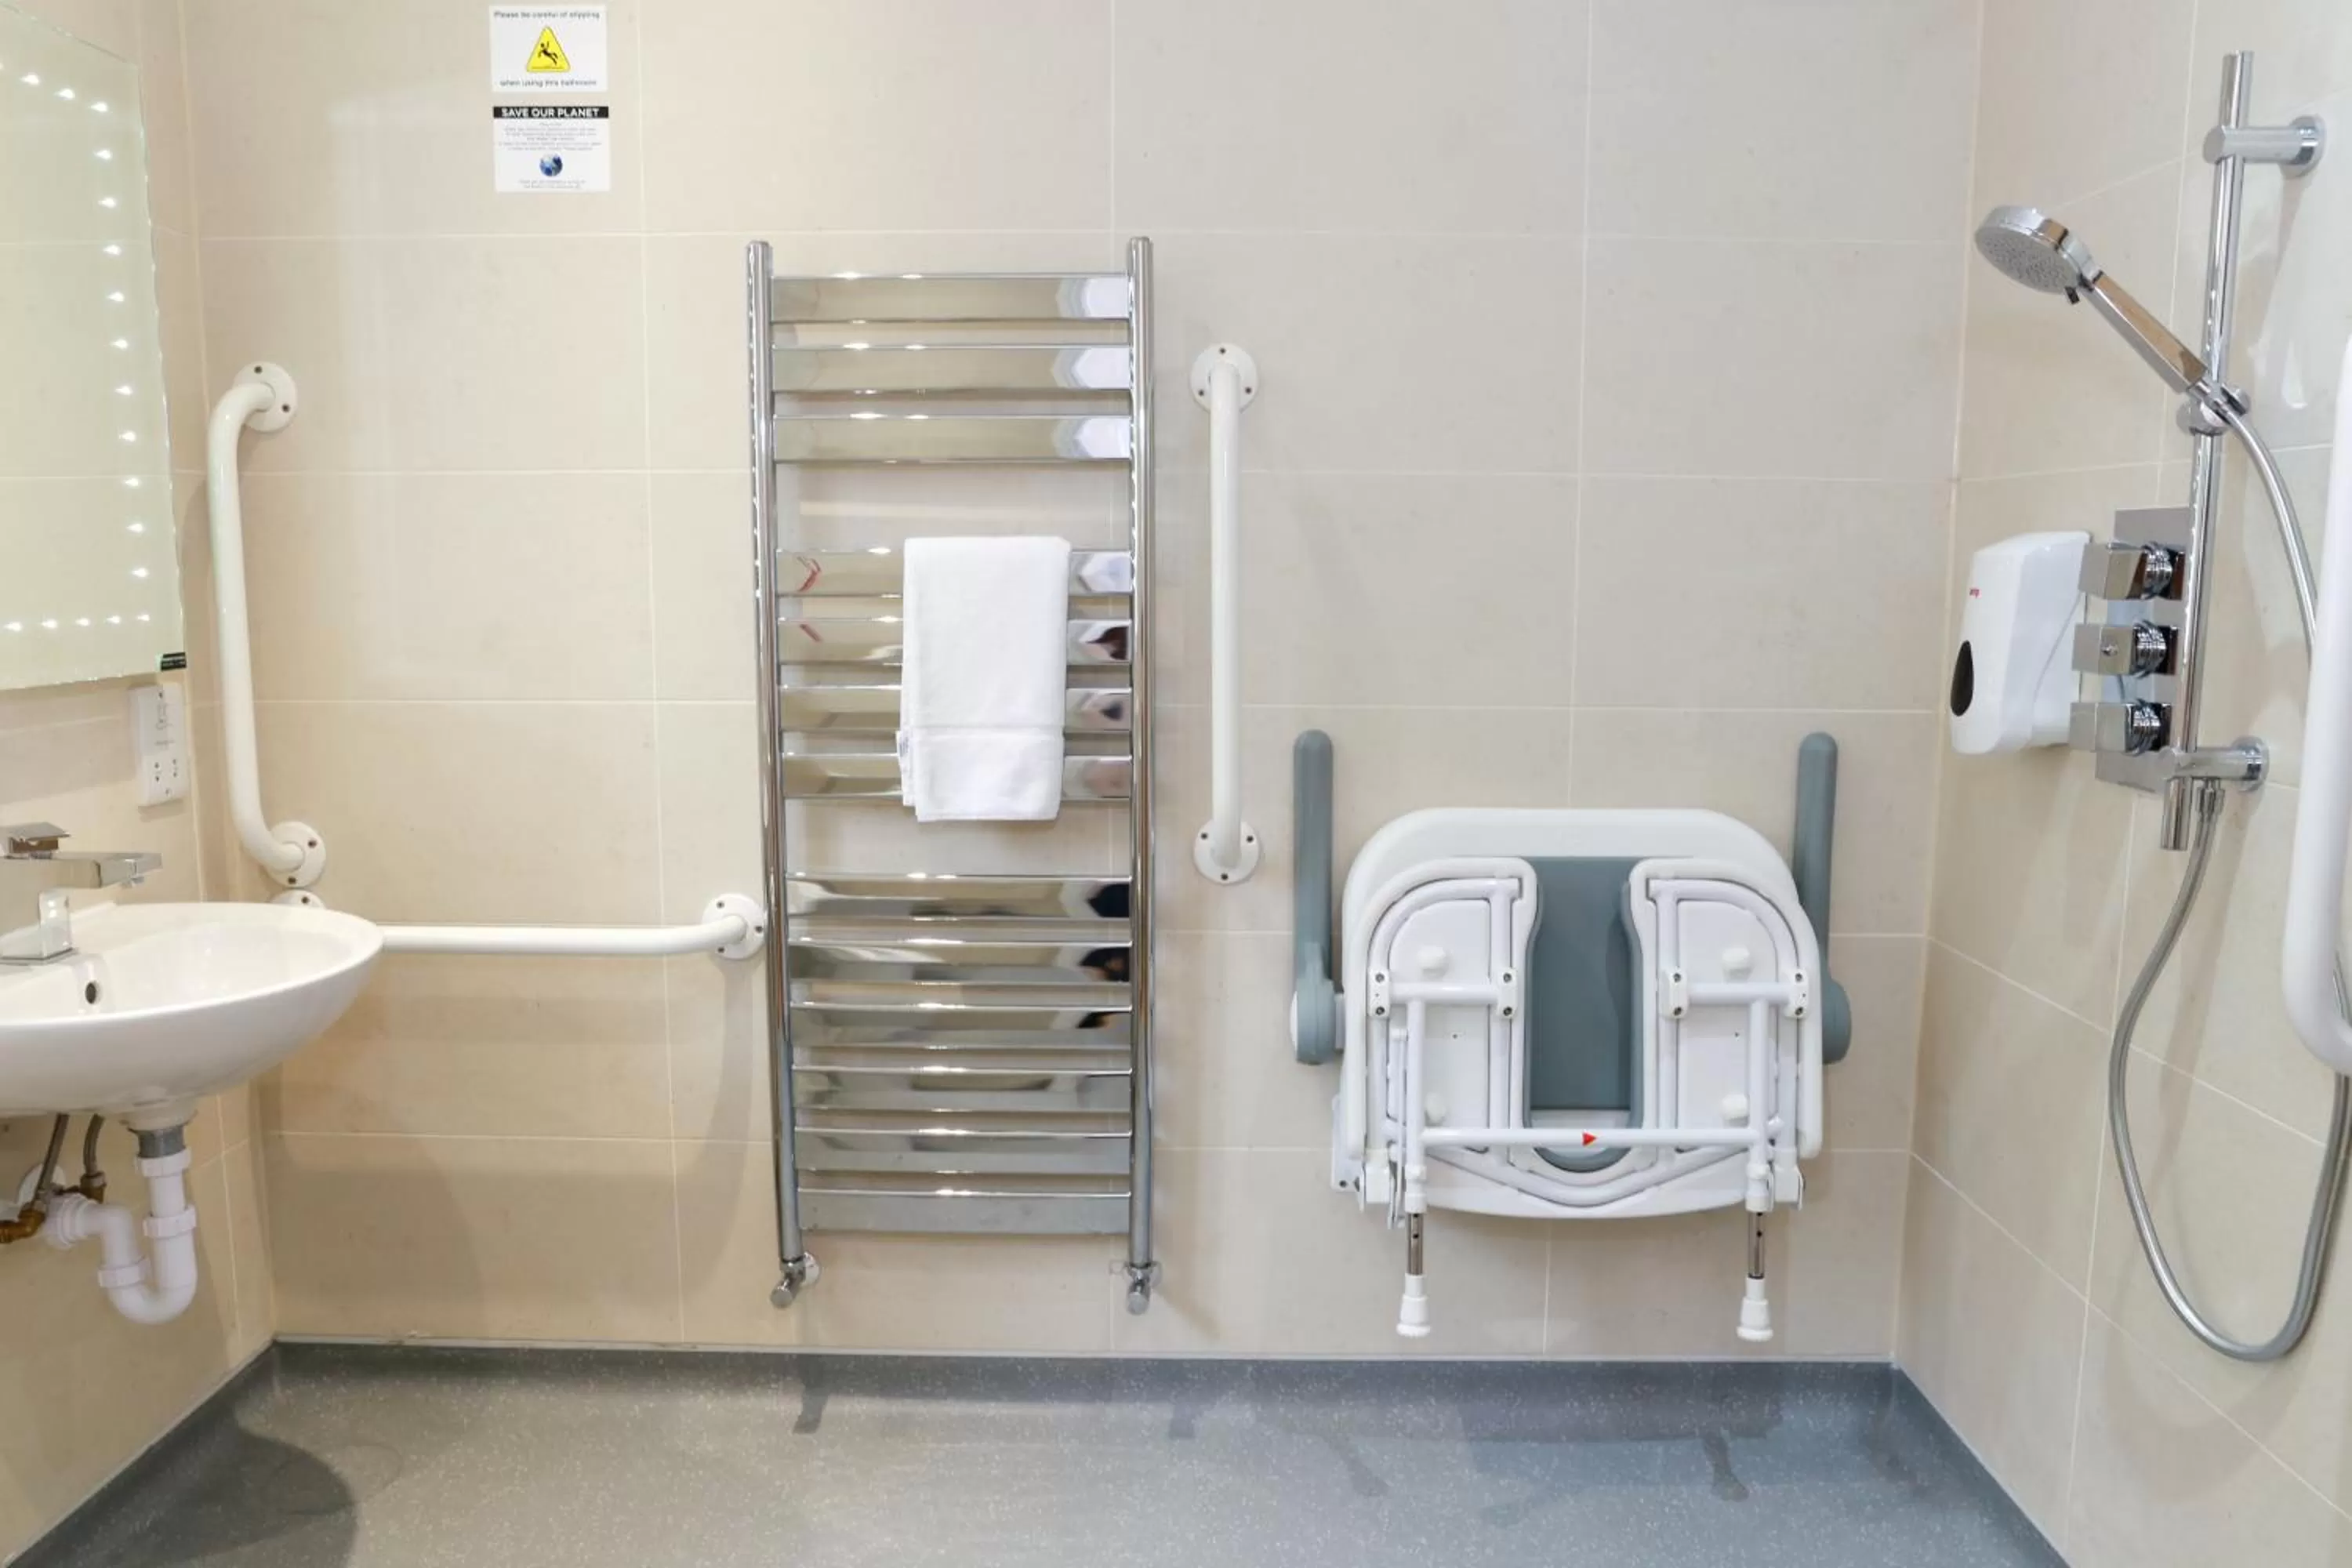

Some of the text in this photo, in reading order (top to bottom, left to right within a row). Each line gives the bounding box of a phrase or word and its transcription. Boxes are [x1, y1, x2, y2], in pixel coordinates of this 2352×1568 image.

[569, 11, 600, 20] slipping
[501, 107, 600, 117] SAVE OUR PLANET
